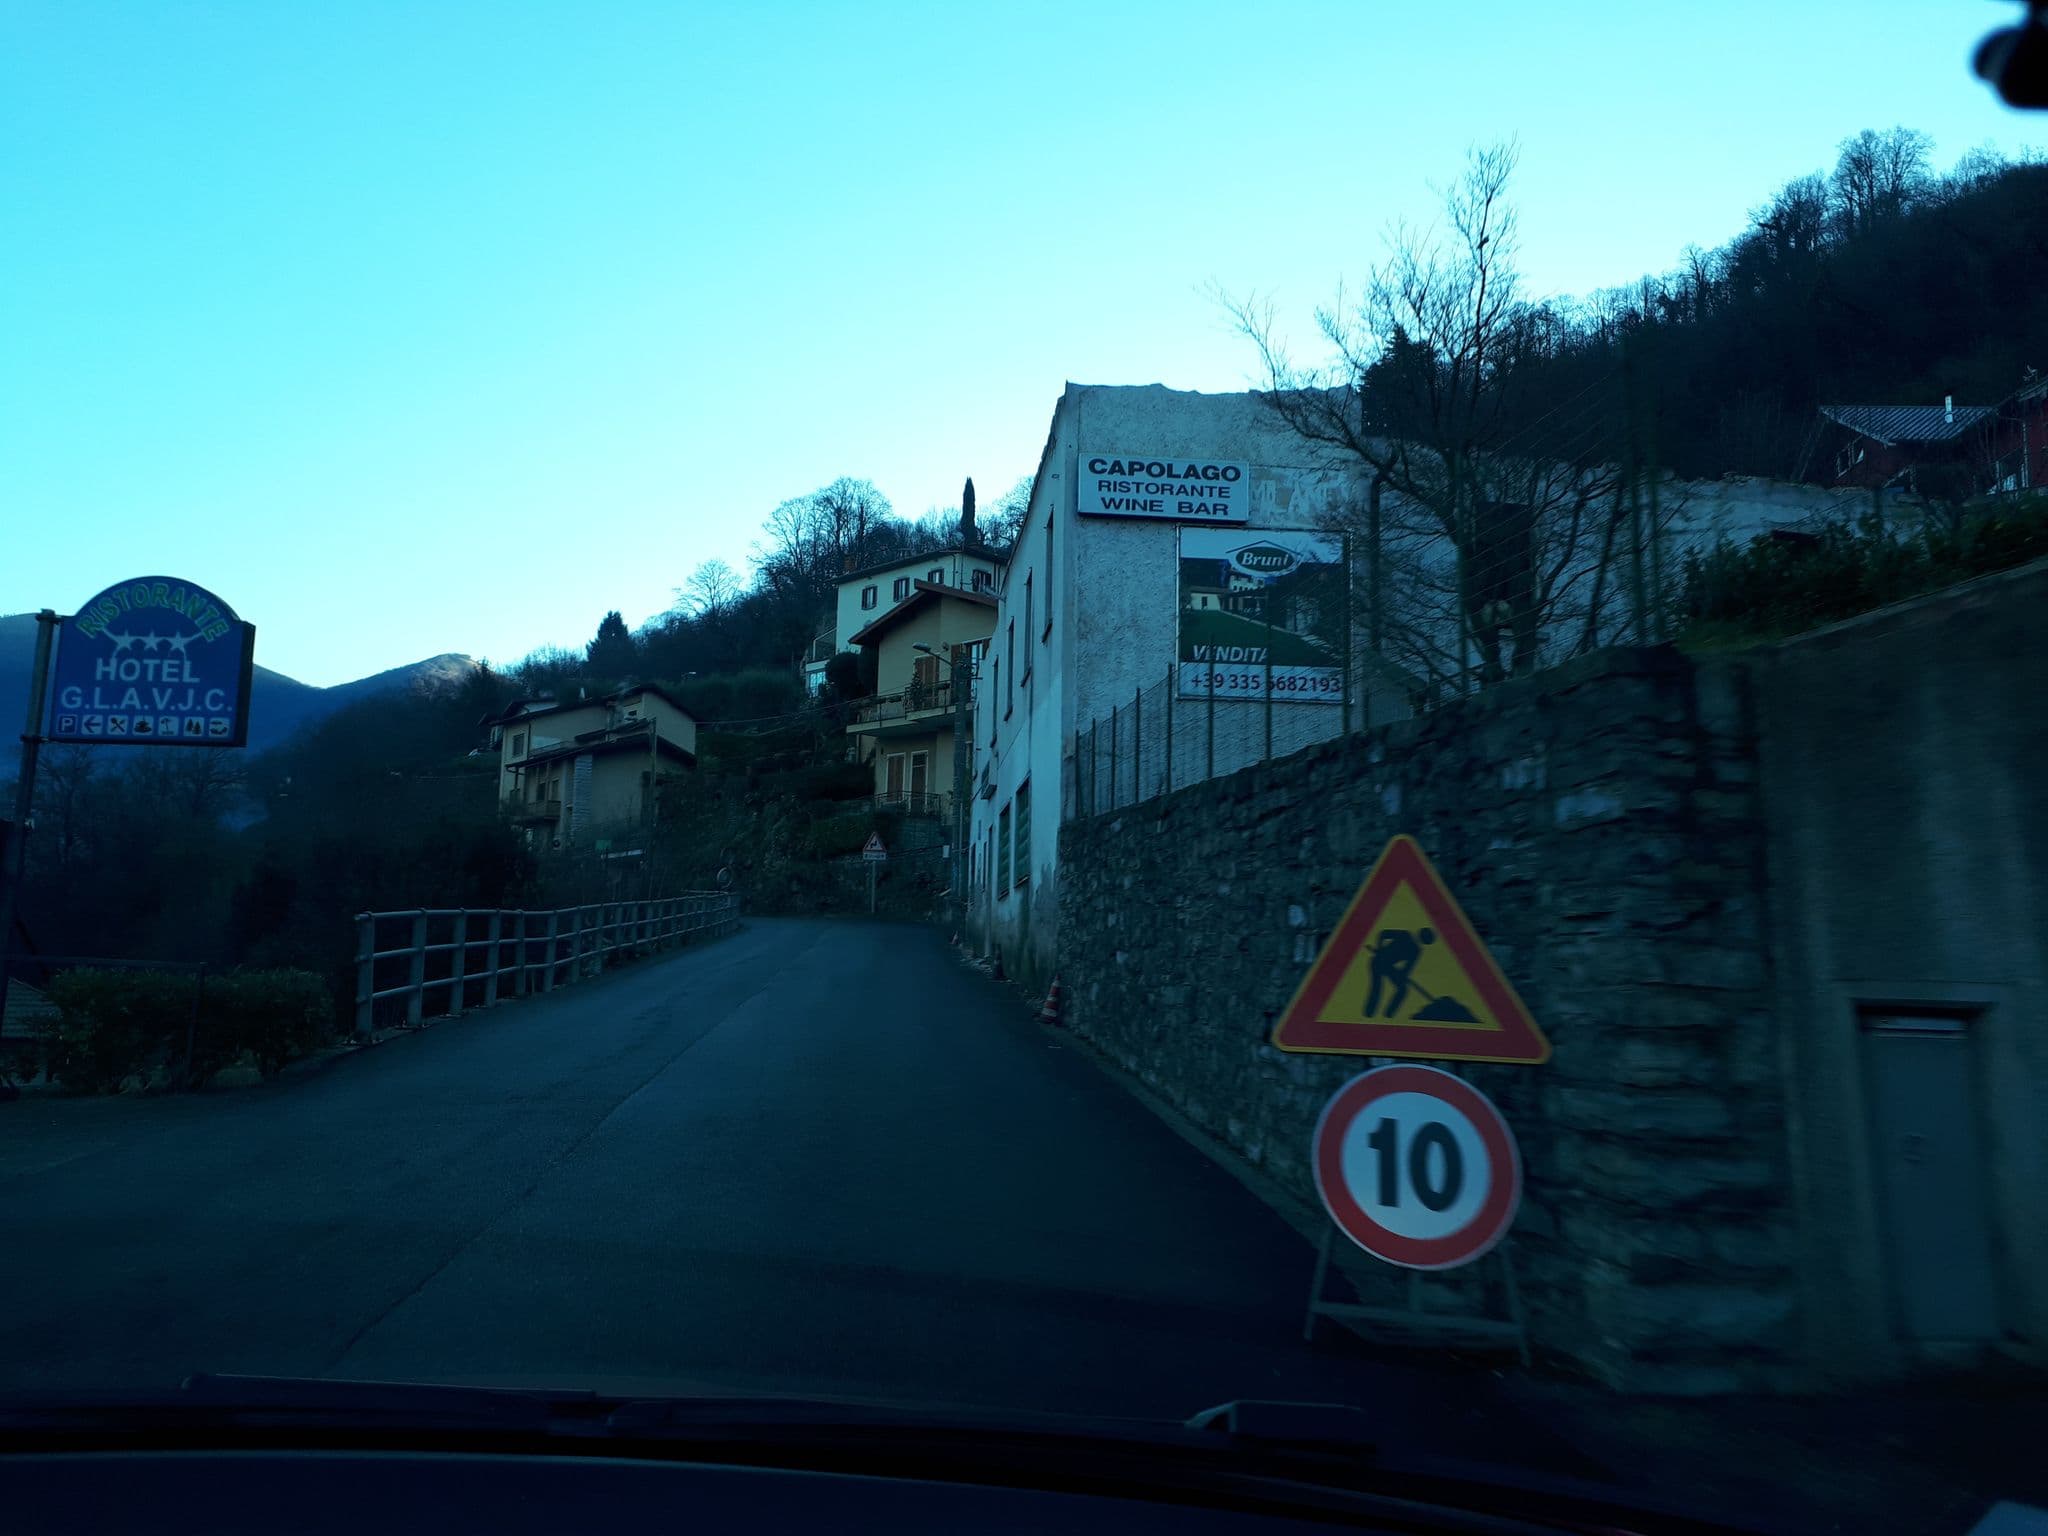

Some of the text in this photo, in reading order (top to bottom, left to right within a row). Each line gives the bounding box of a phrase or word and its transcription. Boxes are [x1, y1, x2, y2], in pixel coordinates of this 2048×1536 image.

[1088, 458, 1241, 482] CAPOLAGO
[1098, 479, 1231, 498] RISTORANTE
[1101, 497, 1228, 516] WINE BAR
[1240, 552, 1290, 567] Bruni
[76, 583, 230, 642] RISTORANTE
[96, 658, 200, 683] HOTEL
[1191, 673, 1225, 688] +39
[1229, 674, 1261, 690] 335
[61, 686, 233, 711] G.L.A.V.J.C.
[1367, 1117, 1464, 1213] 10
